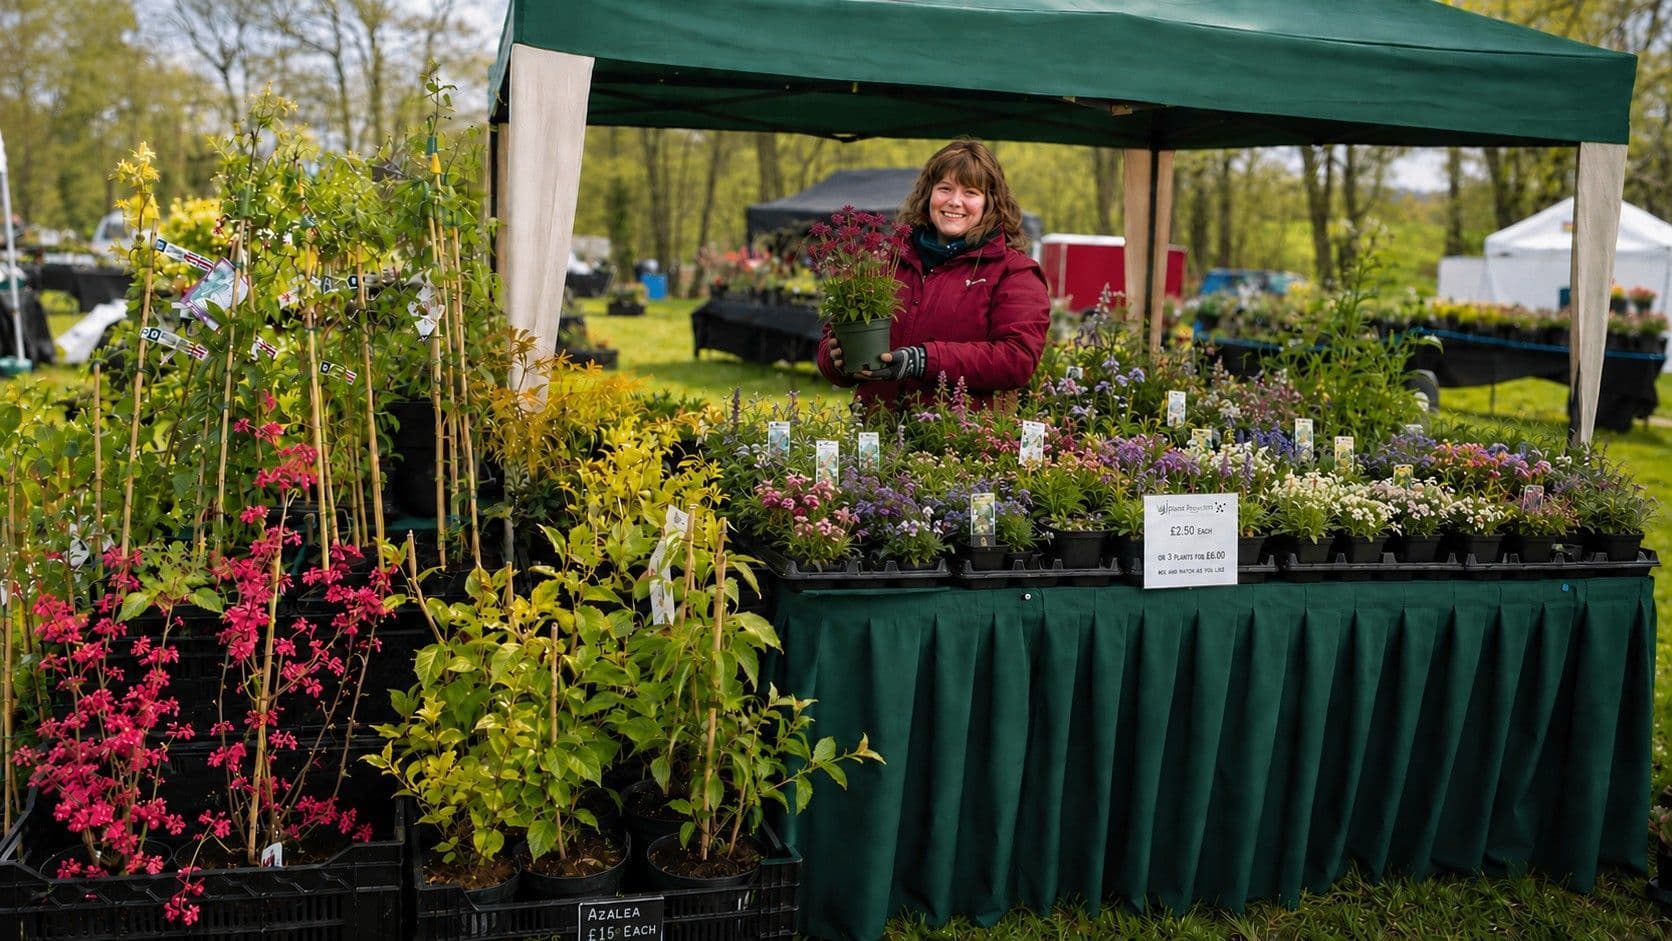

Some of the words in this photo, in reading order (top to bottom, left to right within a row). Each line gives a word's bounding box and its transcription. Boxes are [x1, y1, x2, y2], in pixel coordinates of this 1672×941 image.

[1170, 526, 1194, 536] £2.50
[1206, 551, 1226, 560] £6.00
[588, 907, 640, 921] AZALEA
[624, 924, 656, 937] EACH
